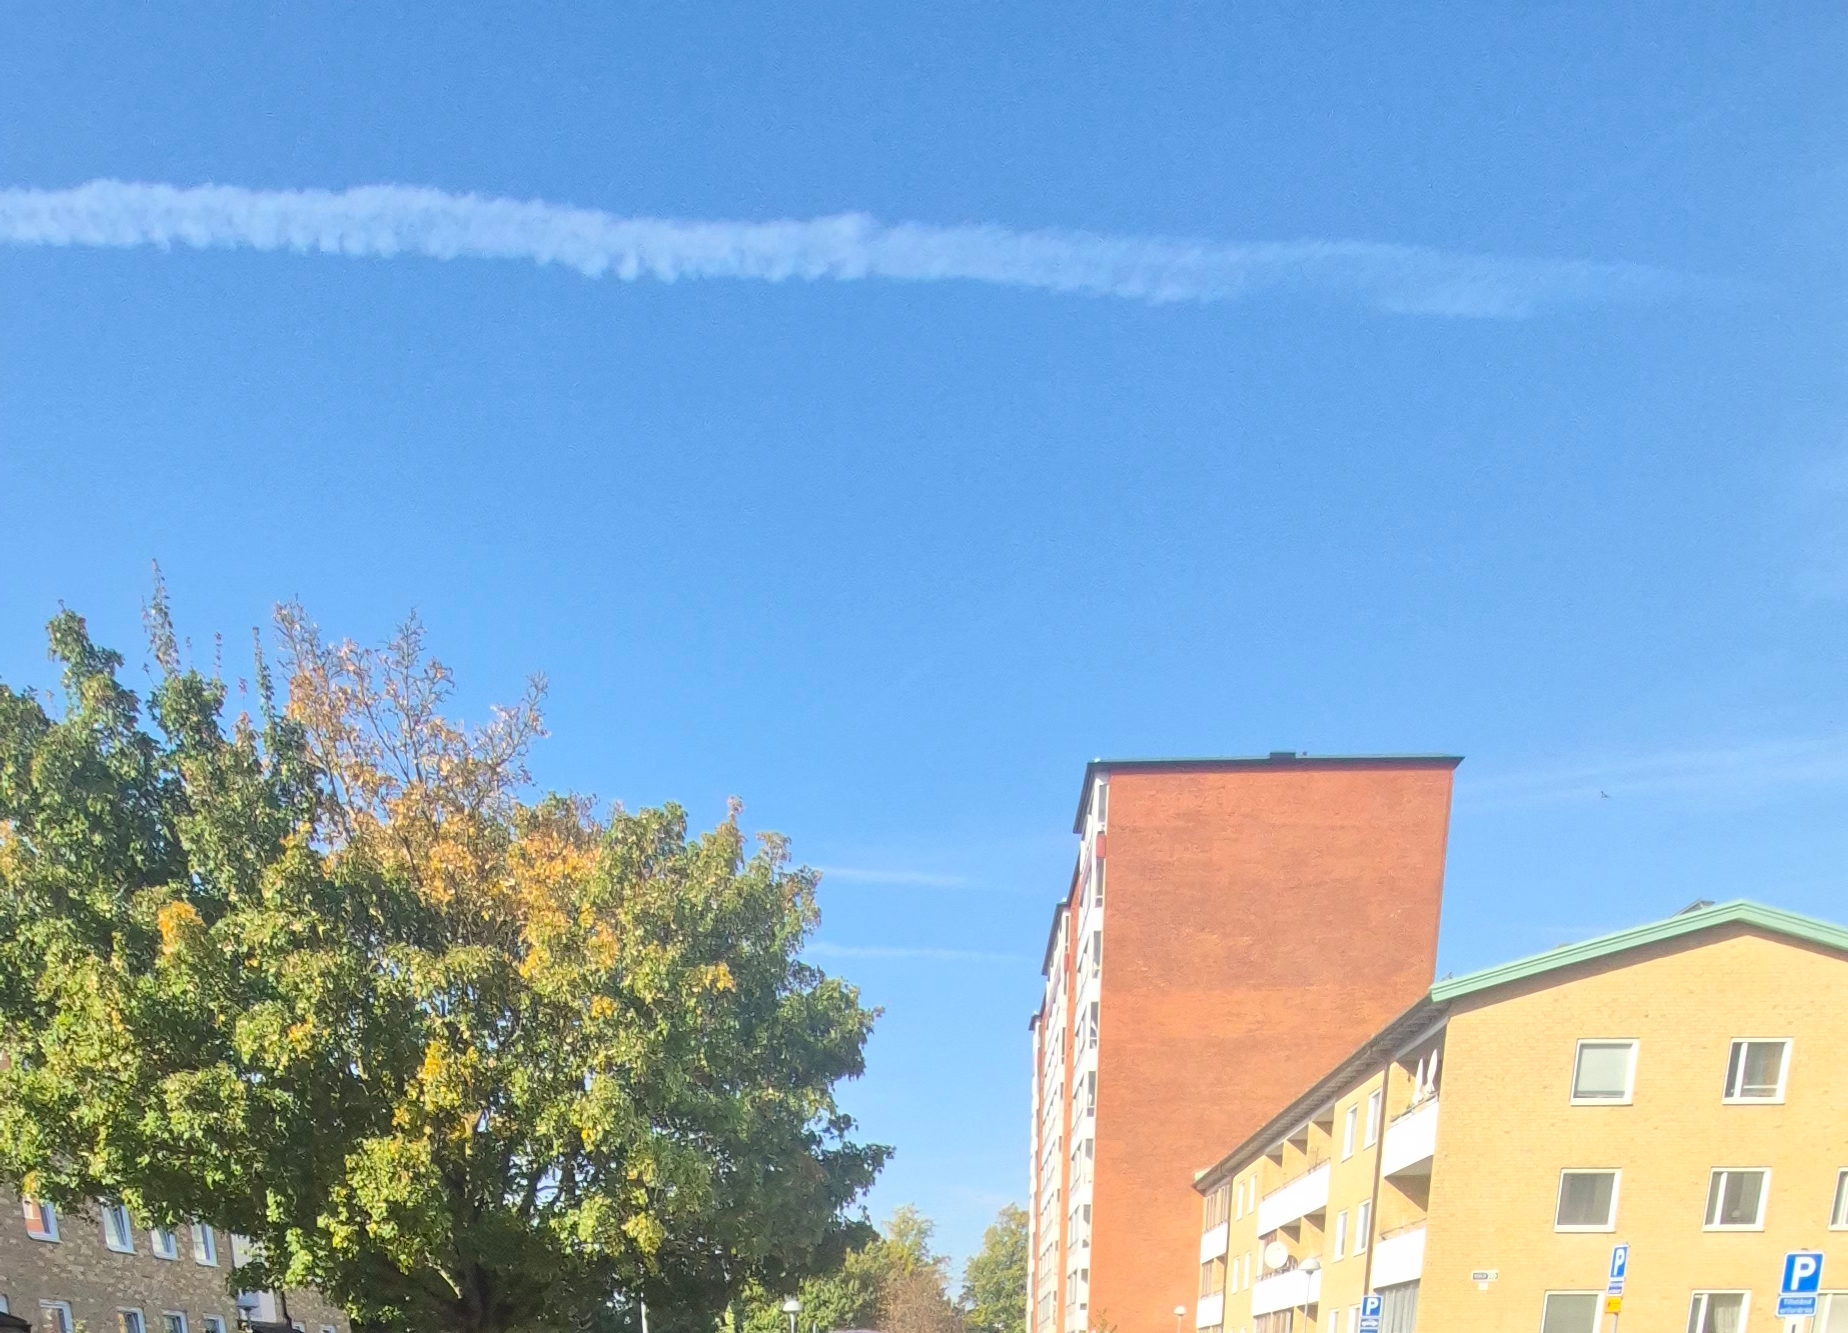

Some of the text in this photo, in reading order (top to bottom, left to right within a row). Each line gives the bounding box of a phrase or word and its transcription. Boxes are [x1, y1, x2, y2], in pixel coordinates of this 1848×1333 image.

[1613, 1248, 1625, 1276] P
[1790, 1256, 1816, 1291] P
[1365, 1297, 1379, 1316] P
